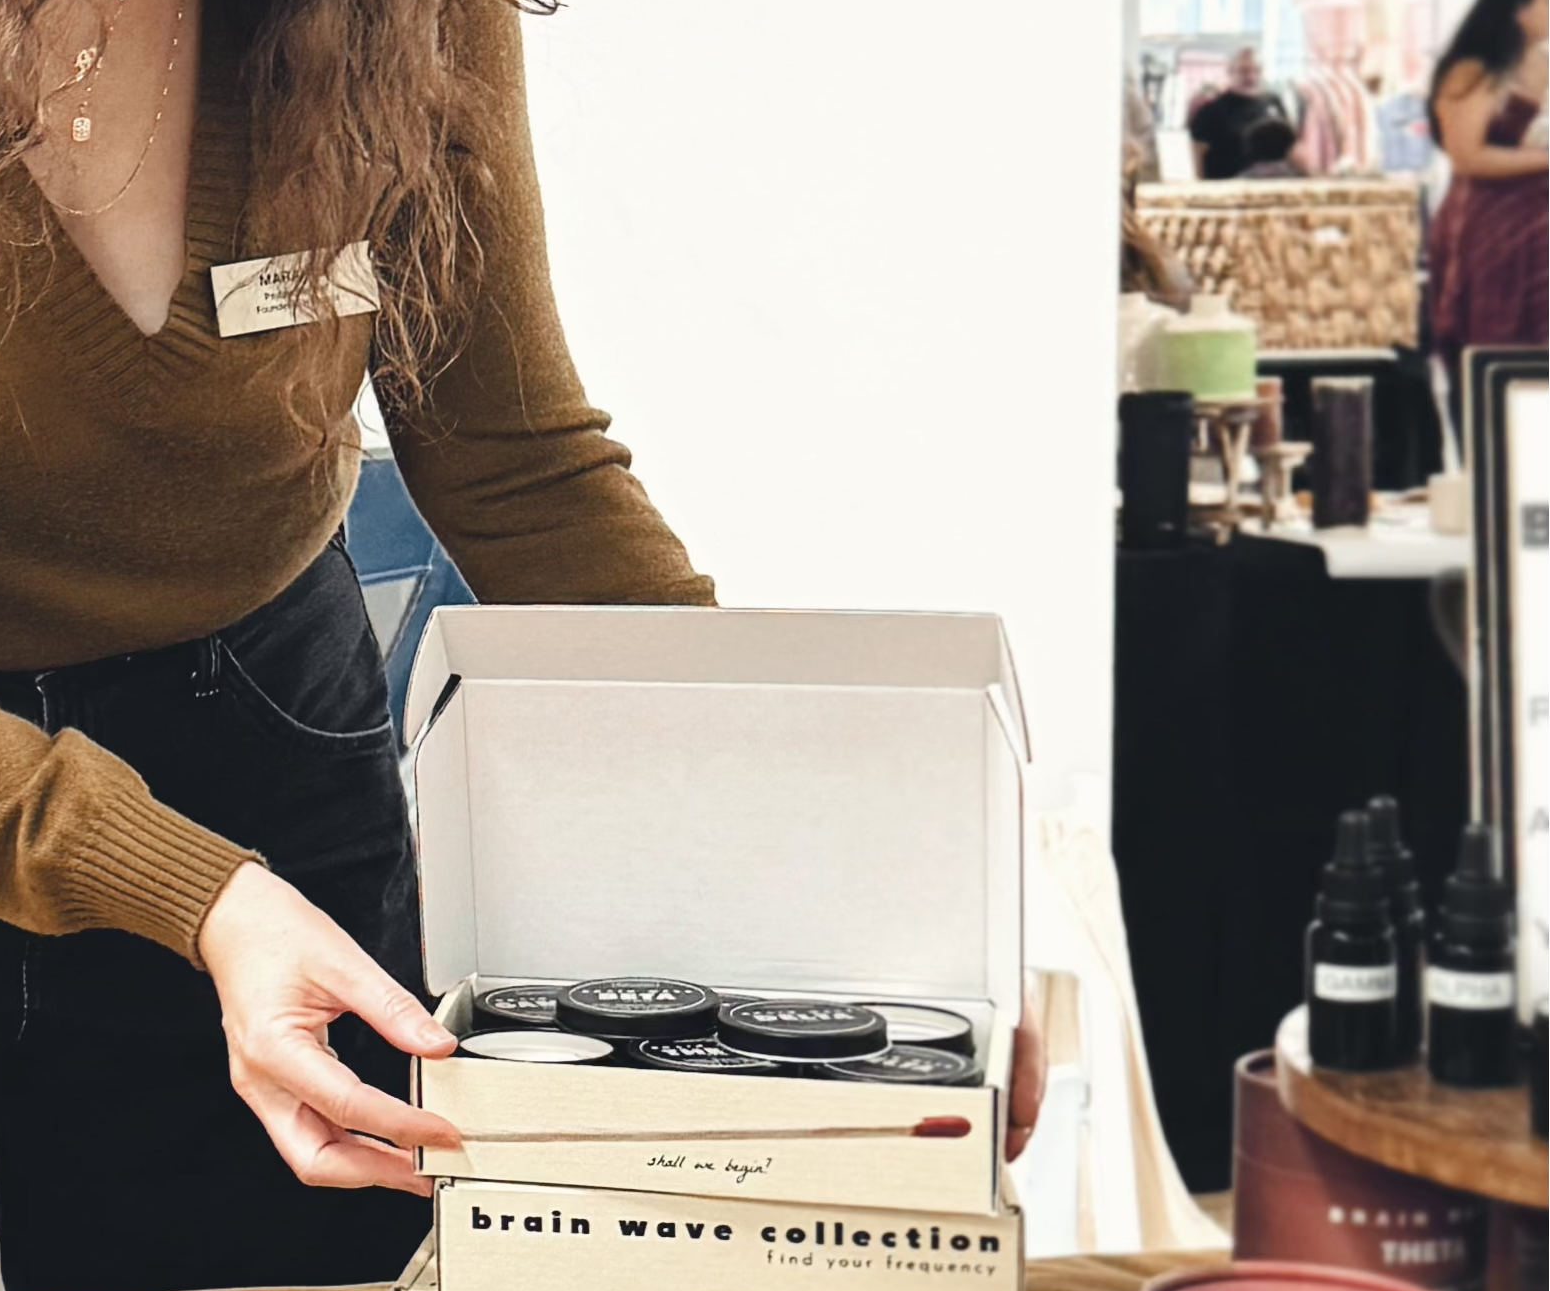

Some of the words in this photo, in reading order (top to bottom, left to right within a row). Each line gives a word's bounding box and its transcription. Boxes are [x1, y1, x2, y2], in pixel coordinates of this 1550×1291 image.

[647, 1154, 687, 1169] shall
[471, 1206, 592, 1237] brain
[618, 1217, 734, 1242] wave
[761, 1220, 1001, 1254] collection
[766, 1248, 814, 1267] find
[826, 1254, 873, 1270] your
[886, 1256, 997, 1277] frequency
